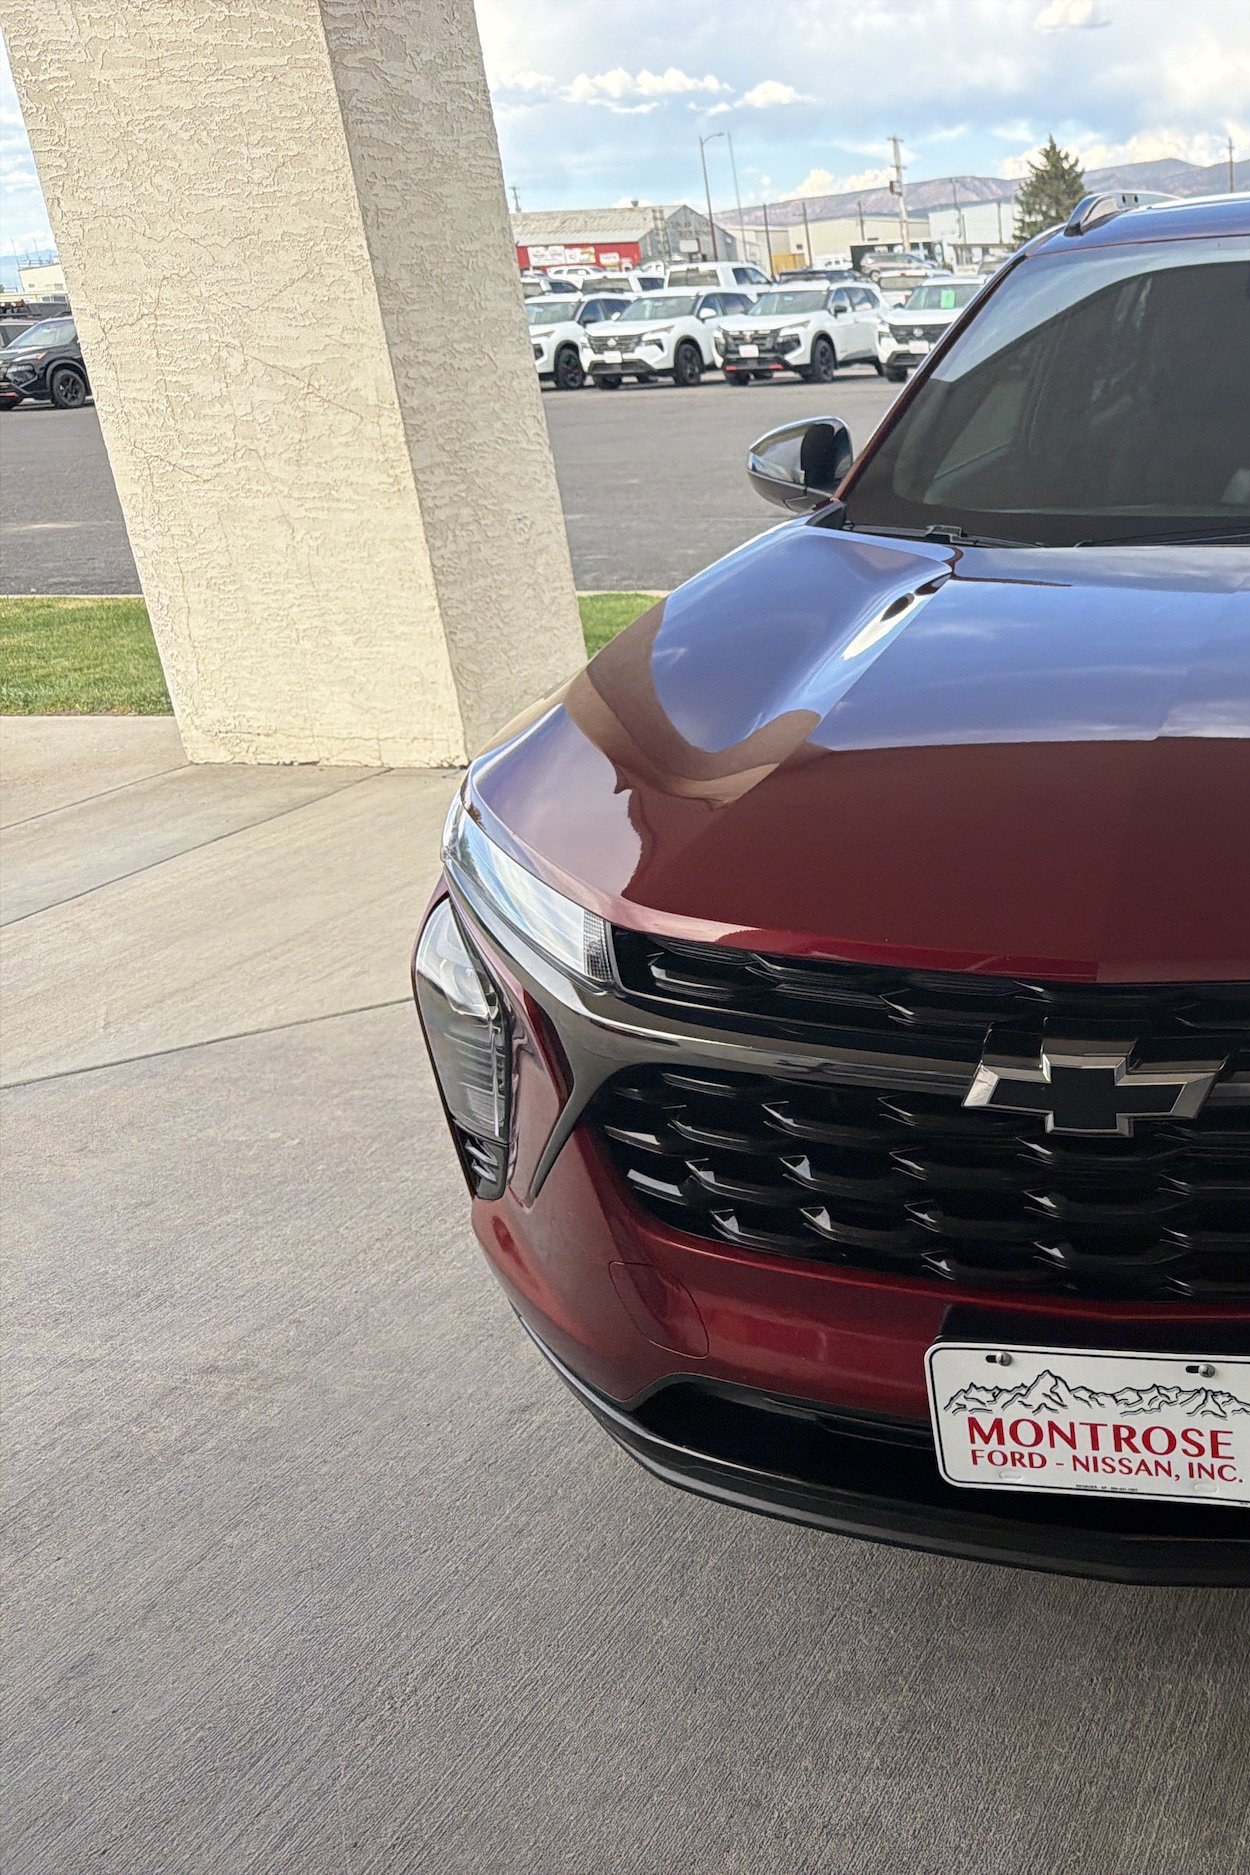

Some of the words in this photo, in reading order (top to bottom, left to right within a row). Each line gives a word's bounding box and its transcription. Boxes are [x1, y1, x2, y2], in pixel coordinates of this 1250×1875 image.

[967, 1416, 1235, 1460] MONTROSE
[971, 1449, 1047, 1469] FORD
[1072, 1455, 1180, 1481] NISSAN,
[1188, 1462, 1244, 1484] INC.
